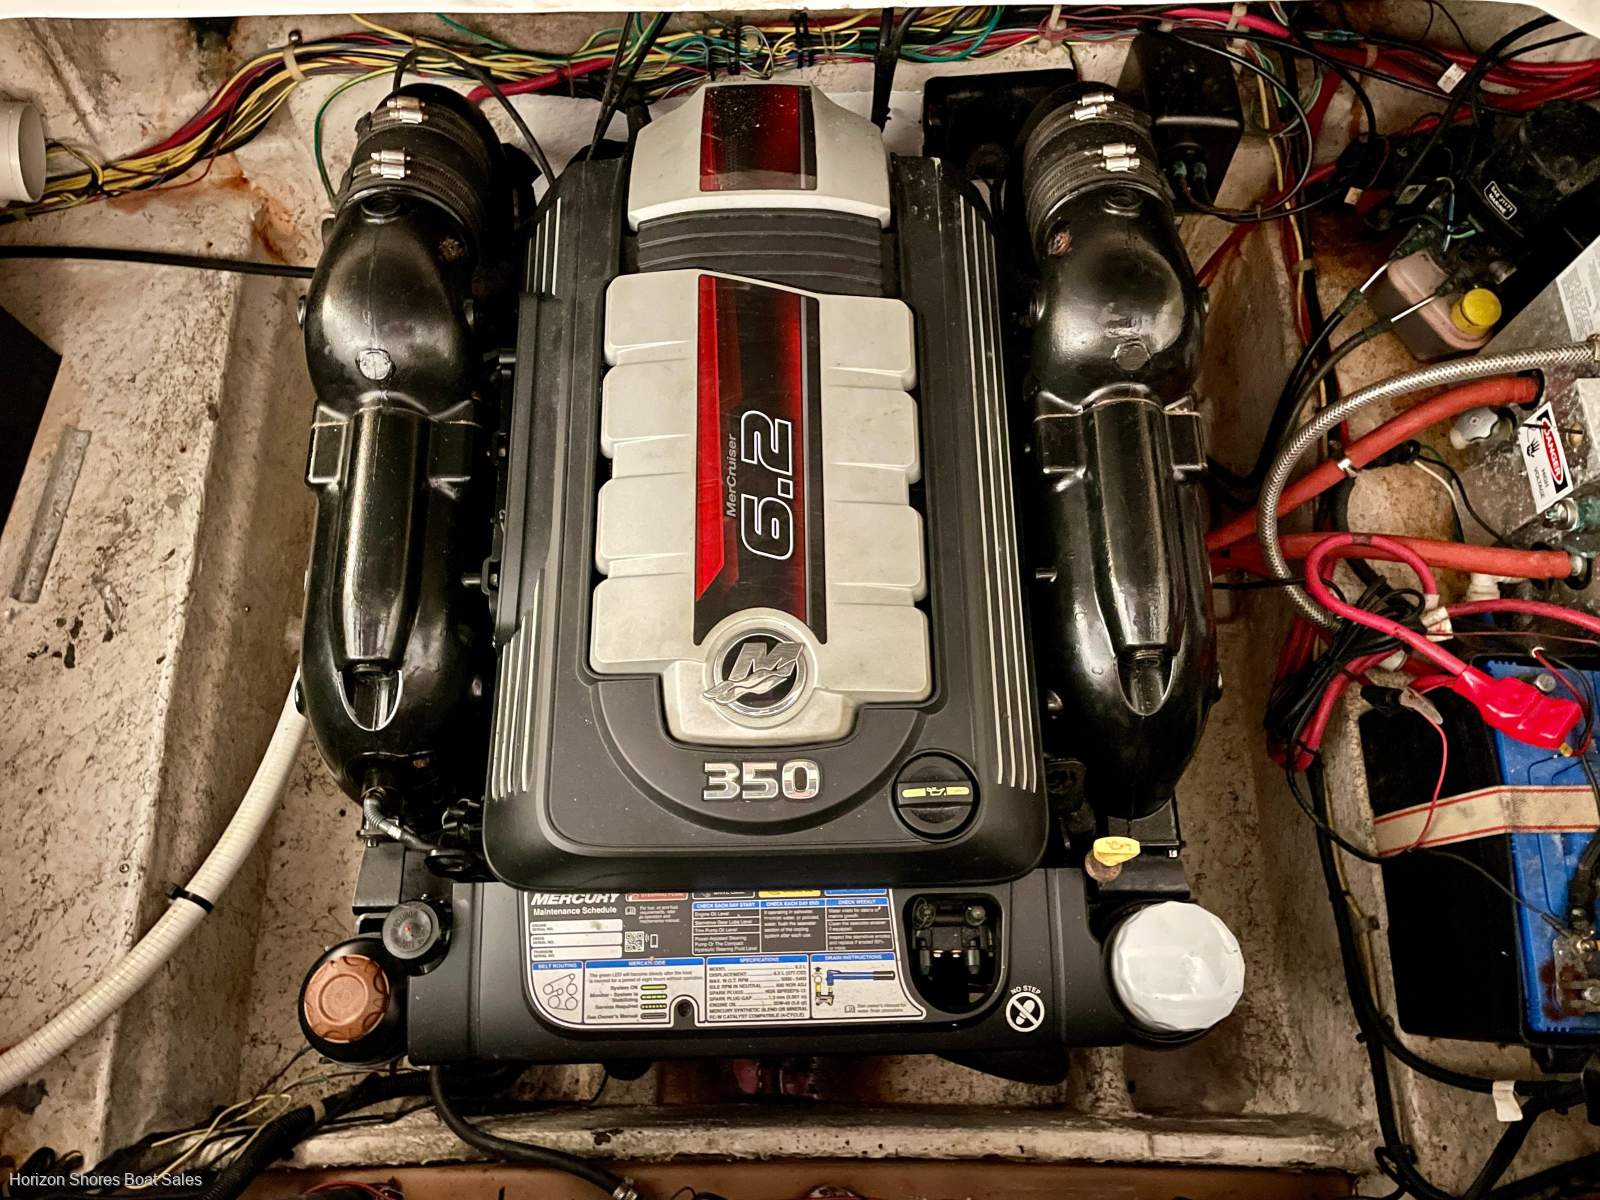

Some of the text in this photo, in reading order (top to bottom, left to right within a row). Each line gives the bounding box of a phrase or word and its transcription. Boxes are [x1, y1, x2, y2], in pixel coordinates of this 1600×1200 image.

[1489, 193, 1507, 214] MARINE
[727, 433, 738, 517] MerCruiser
[740, 410, 794, 561] 6.2
[703, 761, 821, 801] 350
[531, 893, 621, 906] MERCURY
[533, 907, 617, 916] Maintenance Schedule
[1010, 985, 1041, 995] NO STEP
